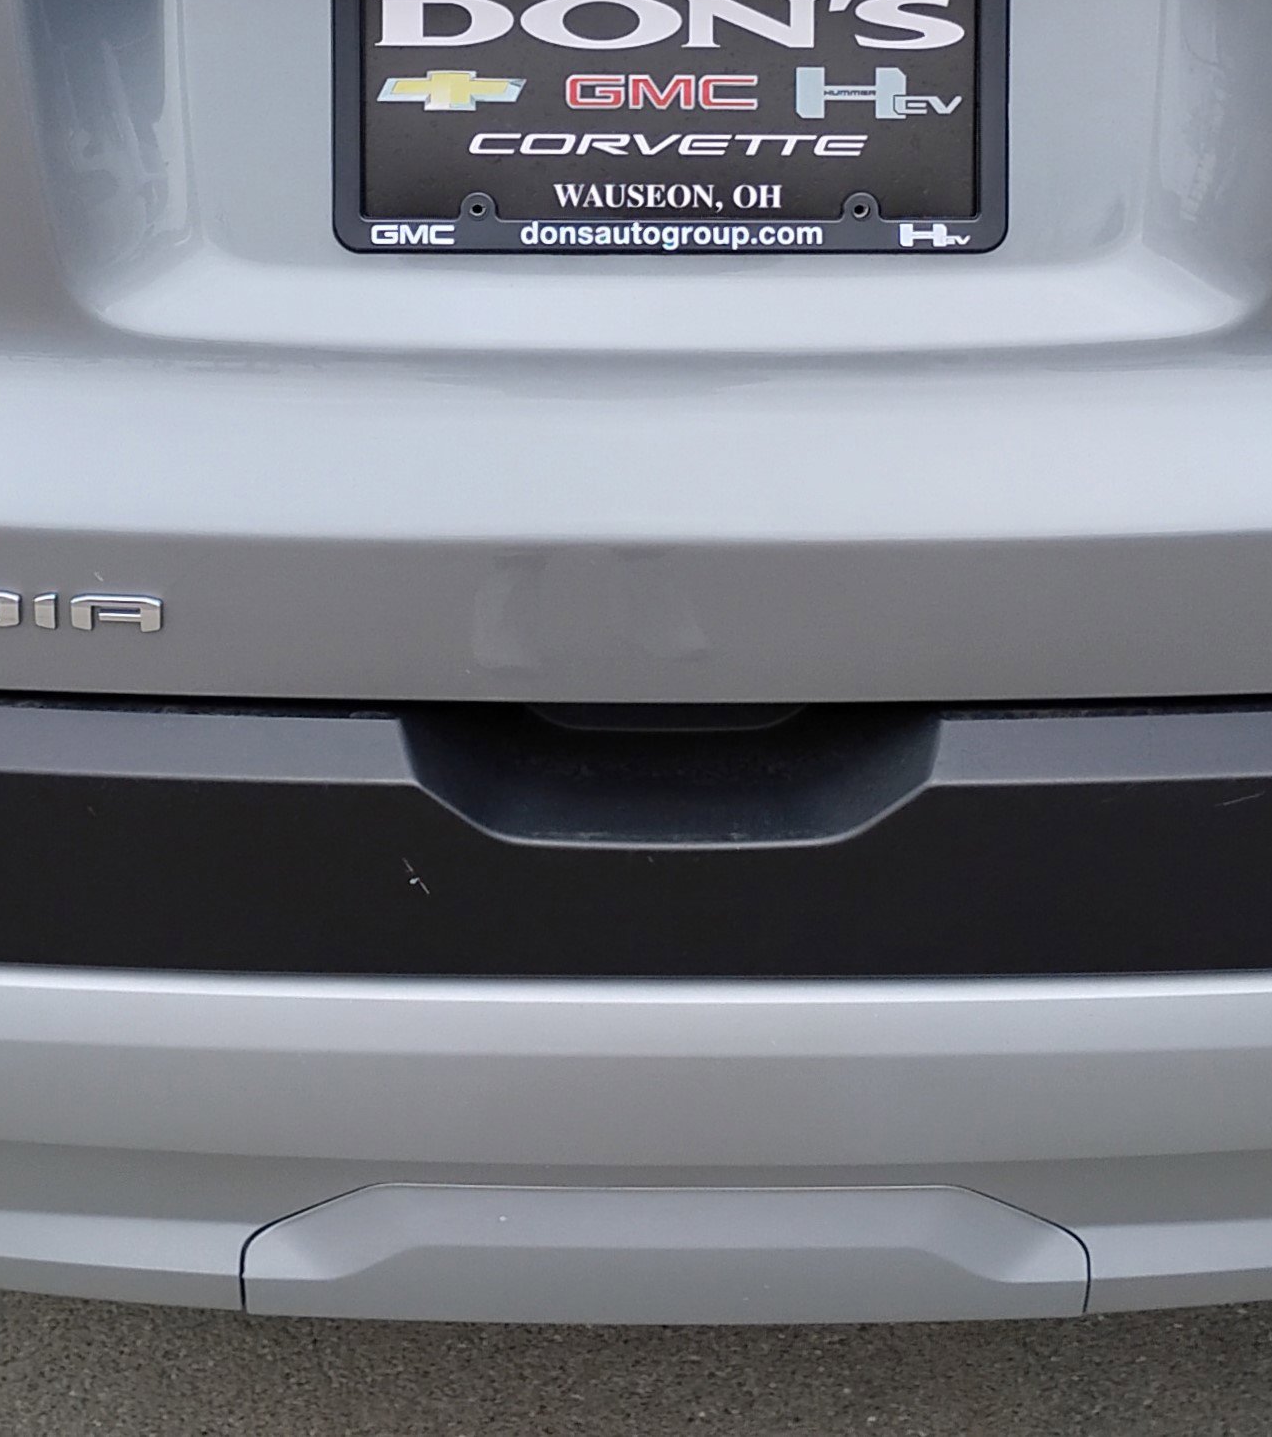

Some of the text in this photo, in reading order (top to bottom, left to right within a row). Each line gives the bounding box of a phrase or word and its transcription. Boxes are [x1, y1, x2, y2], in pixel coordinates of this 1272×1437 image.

[565, 74, 759, 111] GMC
[824, 88, 876, 96] HUMMER
[468, 133, 868, 157] CORVETTE
[553, 183, 782, 213] WAUSEON, OH
[370, 224, 455, 245] GMC
[520, 221, 824, 251] donsautogroup.com
